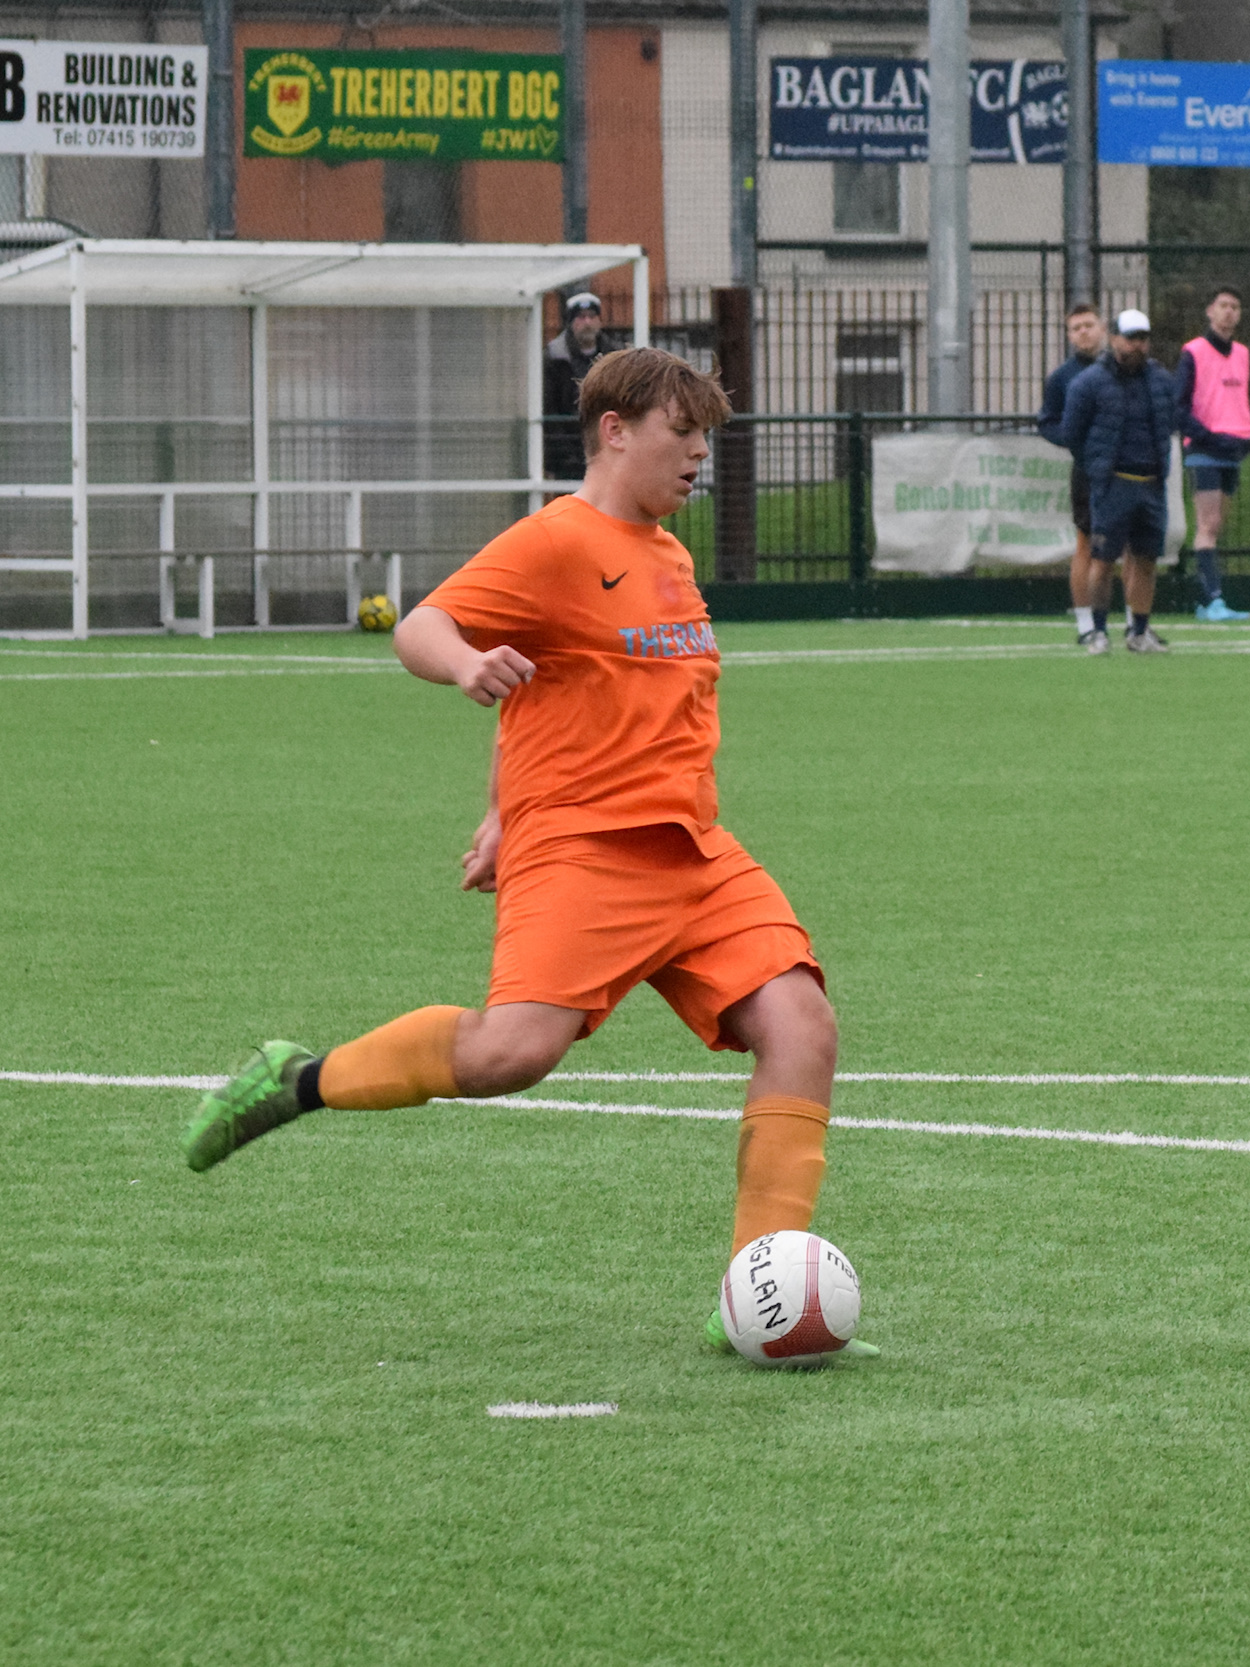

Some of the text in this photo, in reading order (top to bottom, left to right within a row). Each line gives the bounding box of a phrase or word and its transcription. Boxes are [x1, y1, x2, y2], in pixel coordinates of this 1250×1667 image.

[65, 54, 197, 88] BUILDING &
[329, 66, 560, 120] TREHERBERT BGC
[969, 68, 1006, 111] C
[37, 91, 197, 127] RENOVATIONS
[54, 127, 196, 149] Tel: 07415 190739
[952, 479, 990, 512] but
